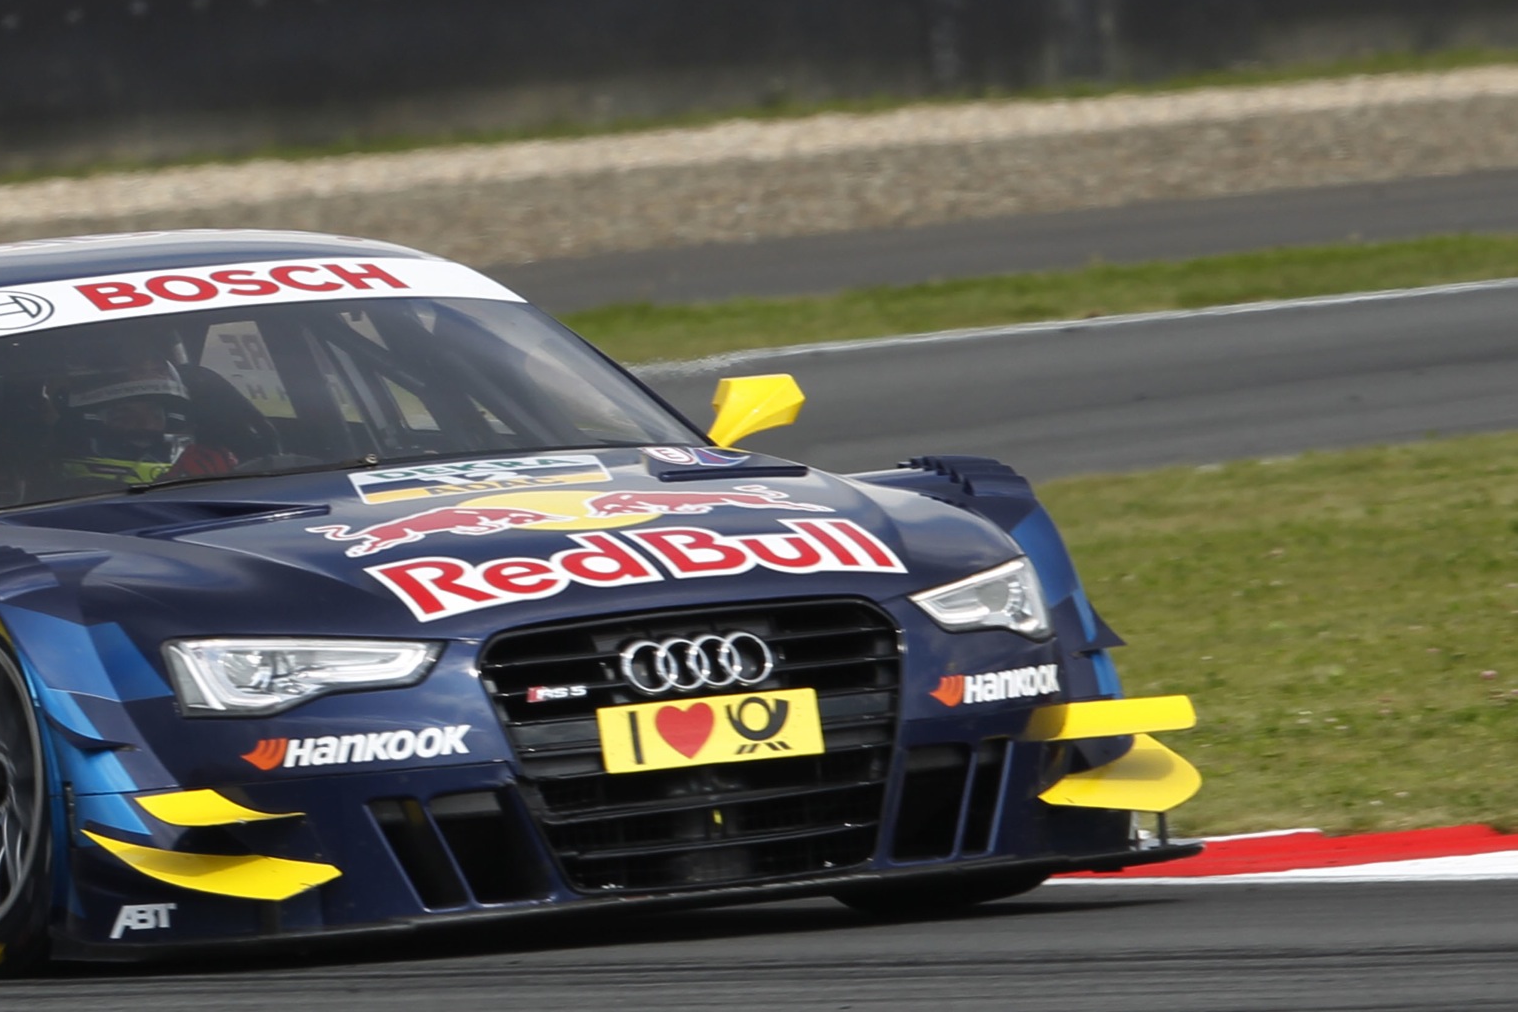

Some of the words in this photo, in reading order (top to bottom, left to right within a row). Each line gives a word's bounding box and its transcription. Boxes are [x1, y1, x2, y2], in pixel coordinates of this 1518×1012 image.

[73, 263, 411, 312] BOSCH
[367, 458, 583, 480] DEKRA
[424, 478, 566, 495] ADAC
[366, 532, 662, 620] Red
[625, 520, 906, 577] Bull
[628, 710, 644, 765] I
[110, 903, 177, 939] ABT
